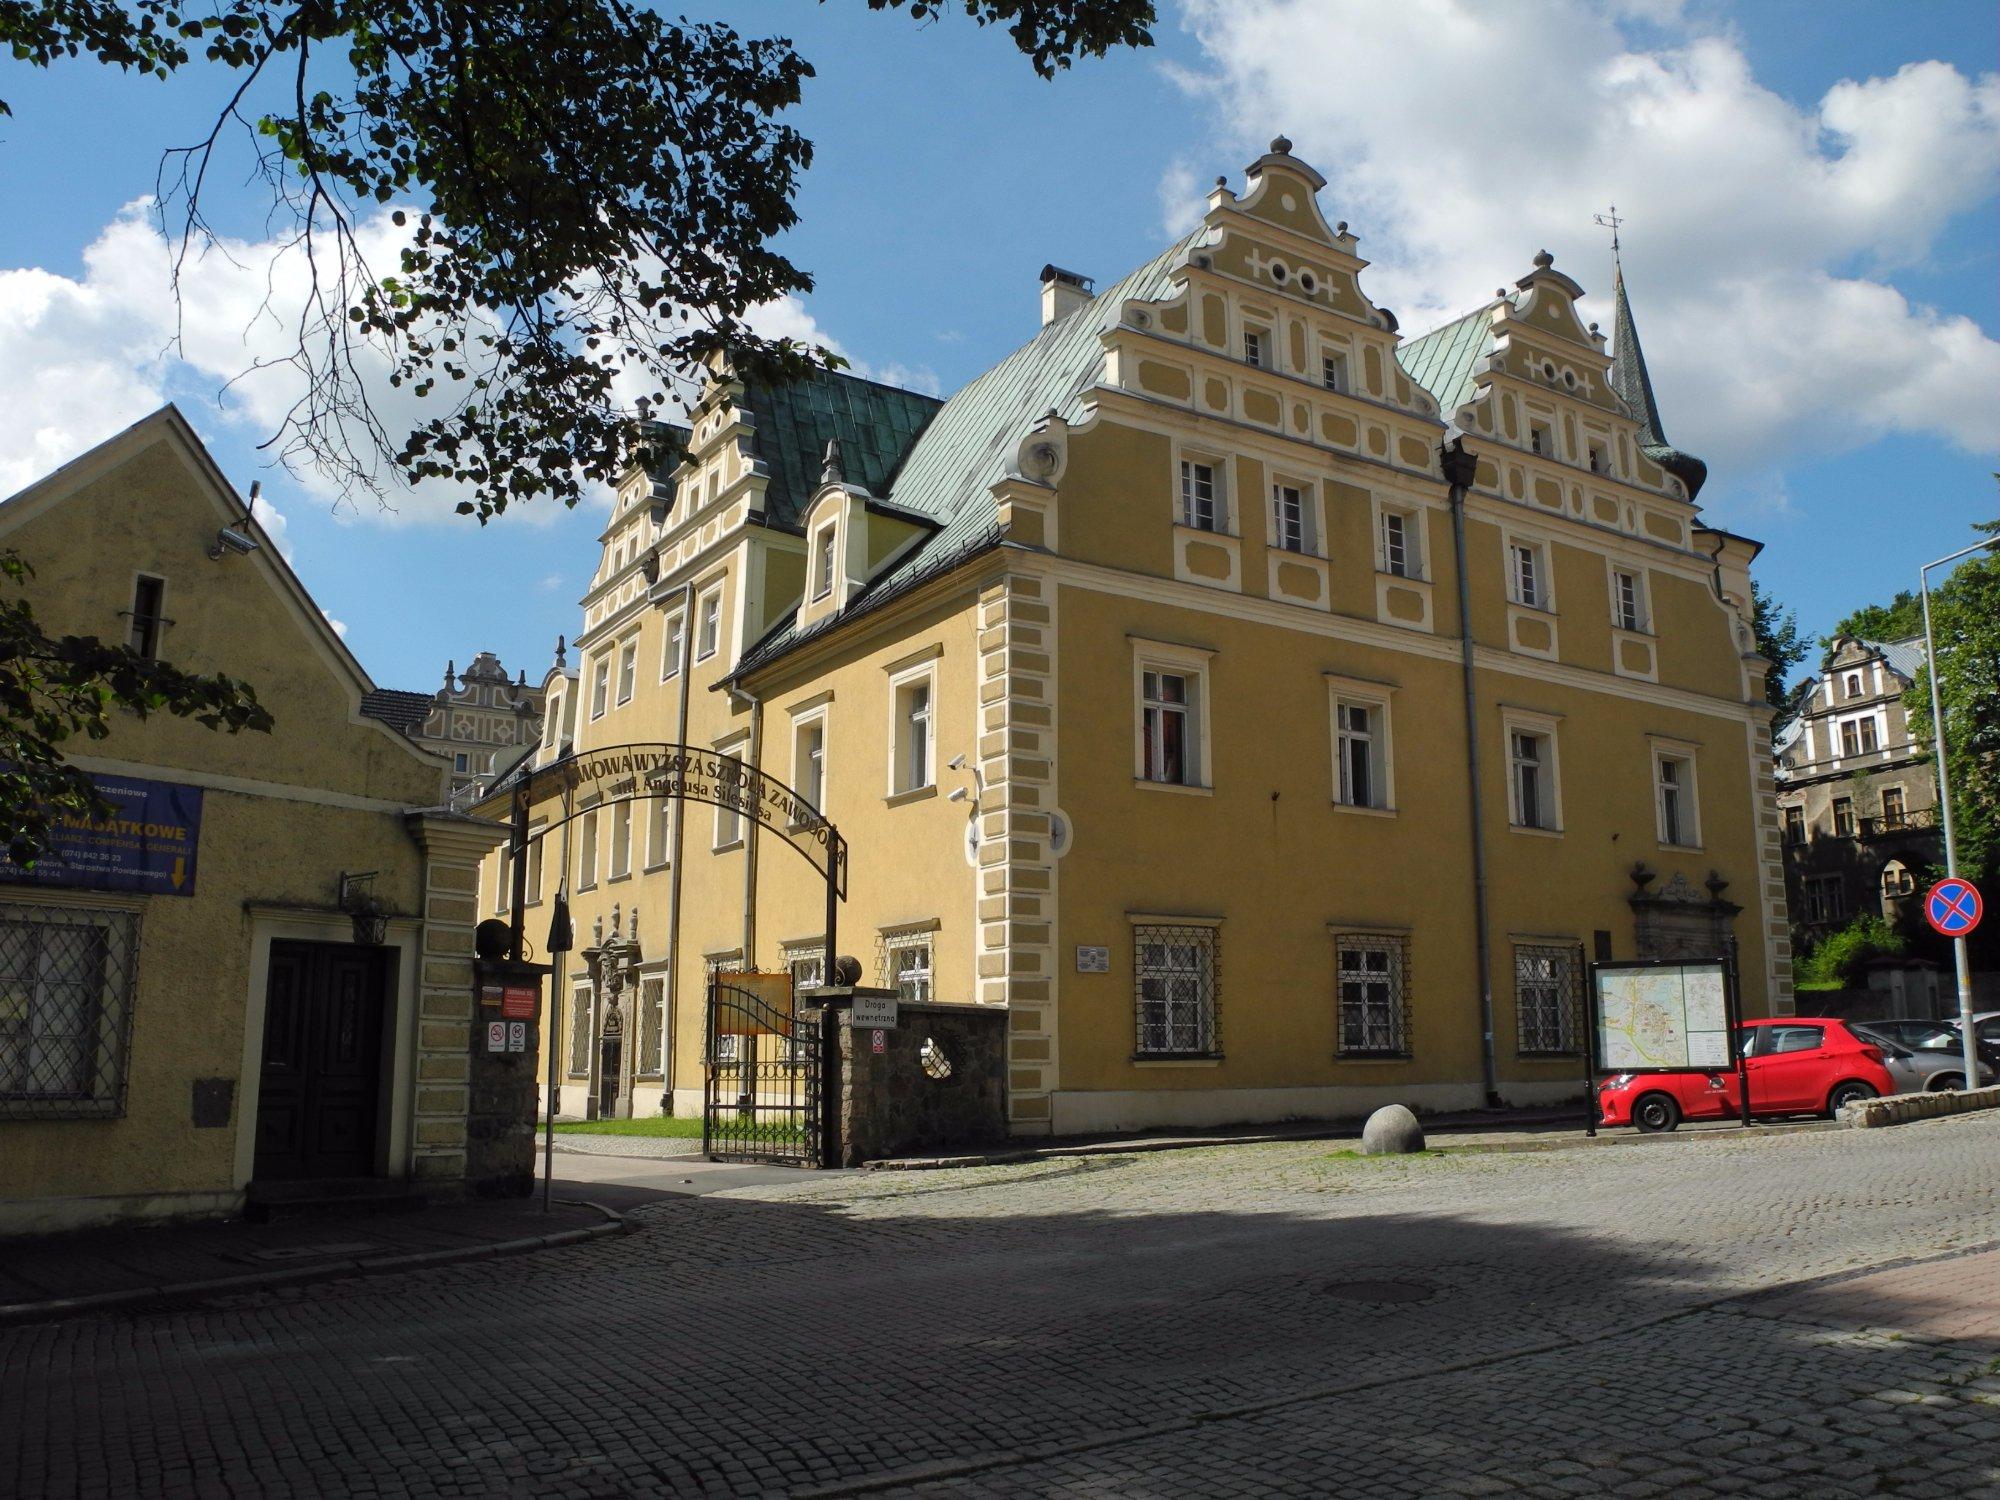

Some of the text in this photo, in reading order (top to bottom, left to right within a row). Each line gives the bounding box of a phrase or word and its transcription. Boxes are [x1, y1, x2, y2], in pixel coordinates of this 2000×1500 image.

[633, 747, 704, 772] WYŻSZA
[768, 789, 845, 867] ZAWODOA
[643, 777, 708, 796] Angeusa
[713, 784, 772, 822] Silesisa
[61, 849, 81, 859] (074)
[865, 999, 886, 1011] Droga
